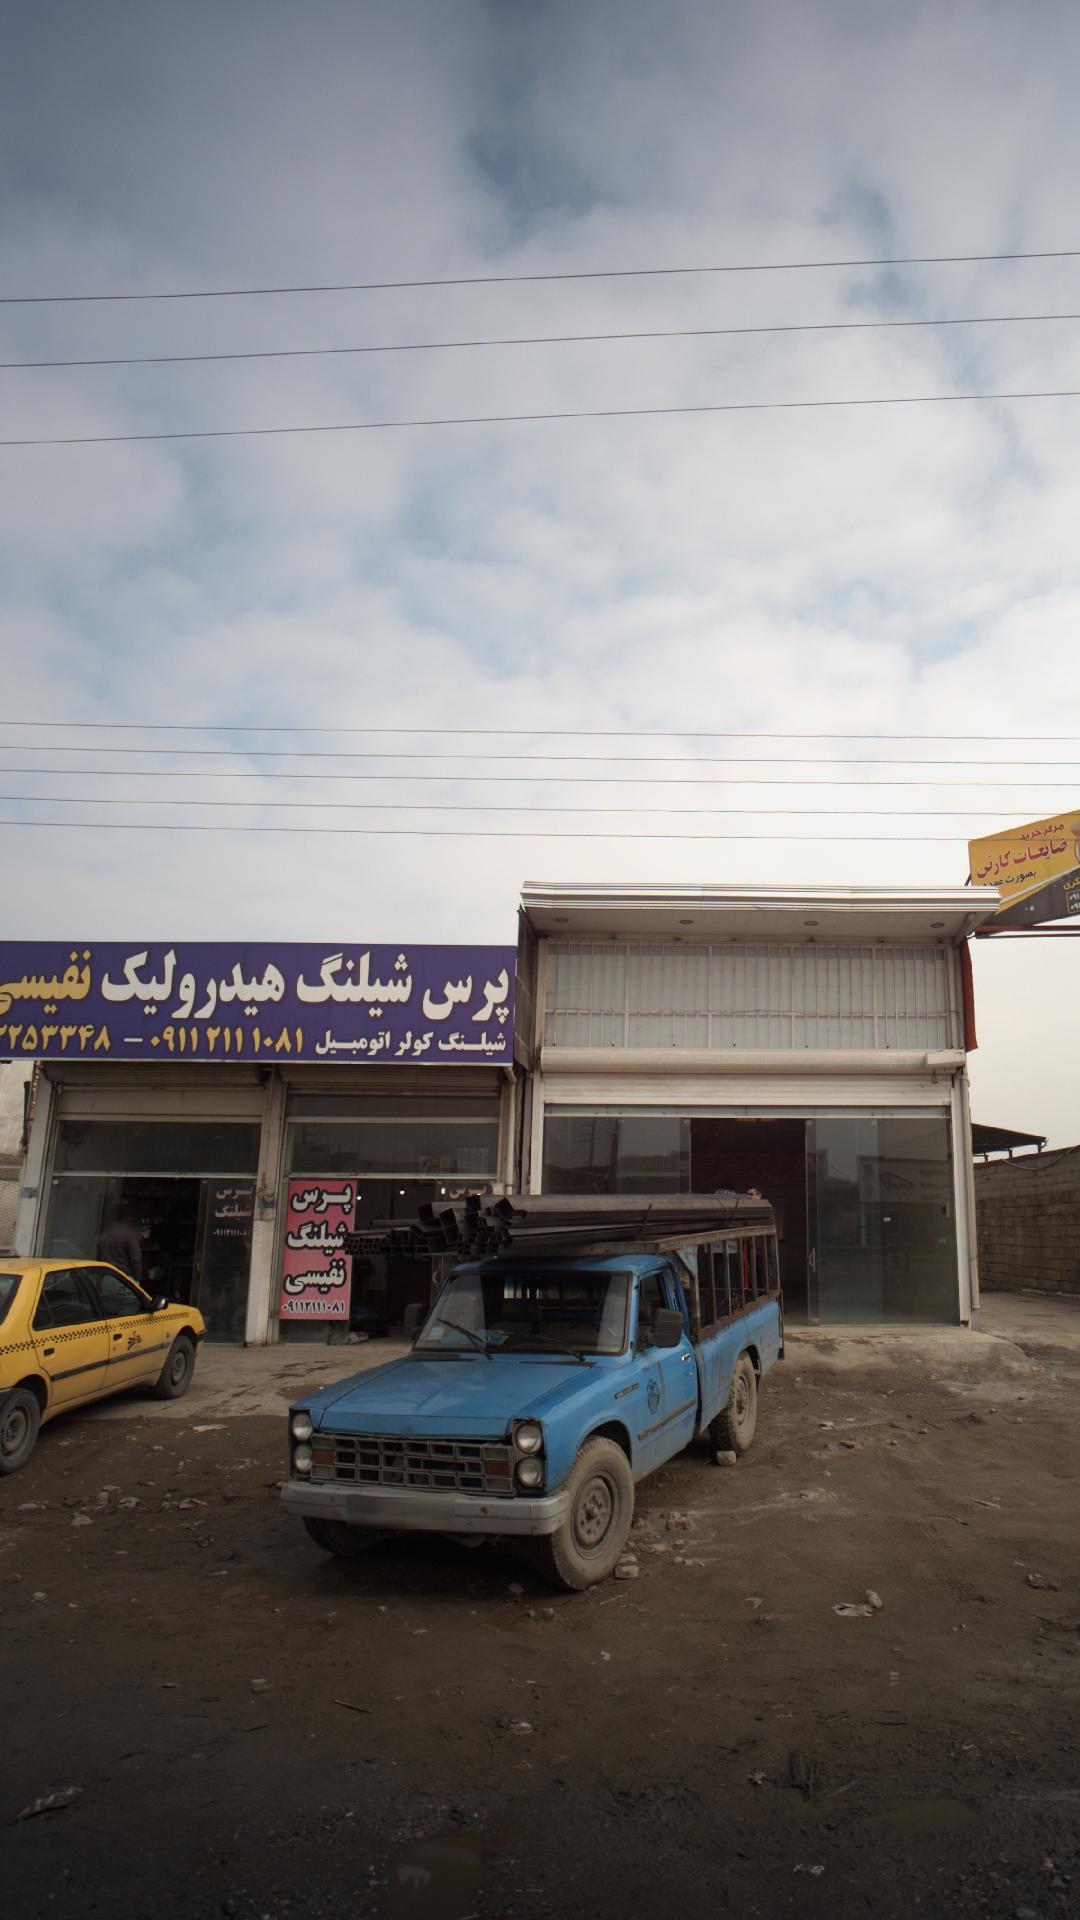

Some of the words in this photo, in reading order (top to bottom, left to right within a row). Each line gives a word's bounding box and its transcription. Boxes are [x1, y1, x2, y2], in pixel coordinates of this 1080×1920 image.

[976, 850, 1011, 879] کارتن
[1013, 838, 1068, 865] ضایعات
[101, 949, 286, 1019] هیدرولیک
[296, 951, 413, 1017] شیلنگ
[422, 968, 510, 1024] پرس
[315, 1030, 391, 1056] اتومبیل
[394, 1030, 434, 1056] کولر
[438, 1031, 506, 1056] شیلنگ
[291, 1183, 353, 1214] پرس
[286, 1221, 347, 1256] شیلنگ
[284, 1258, 346, 1295] نفیسی
[283, 1301, 345, 1313] ۰۹۱۱۲۱۱۱۰۸۱
